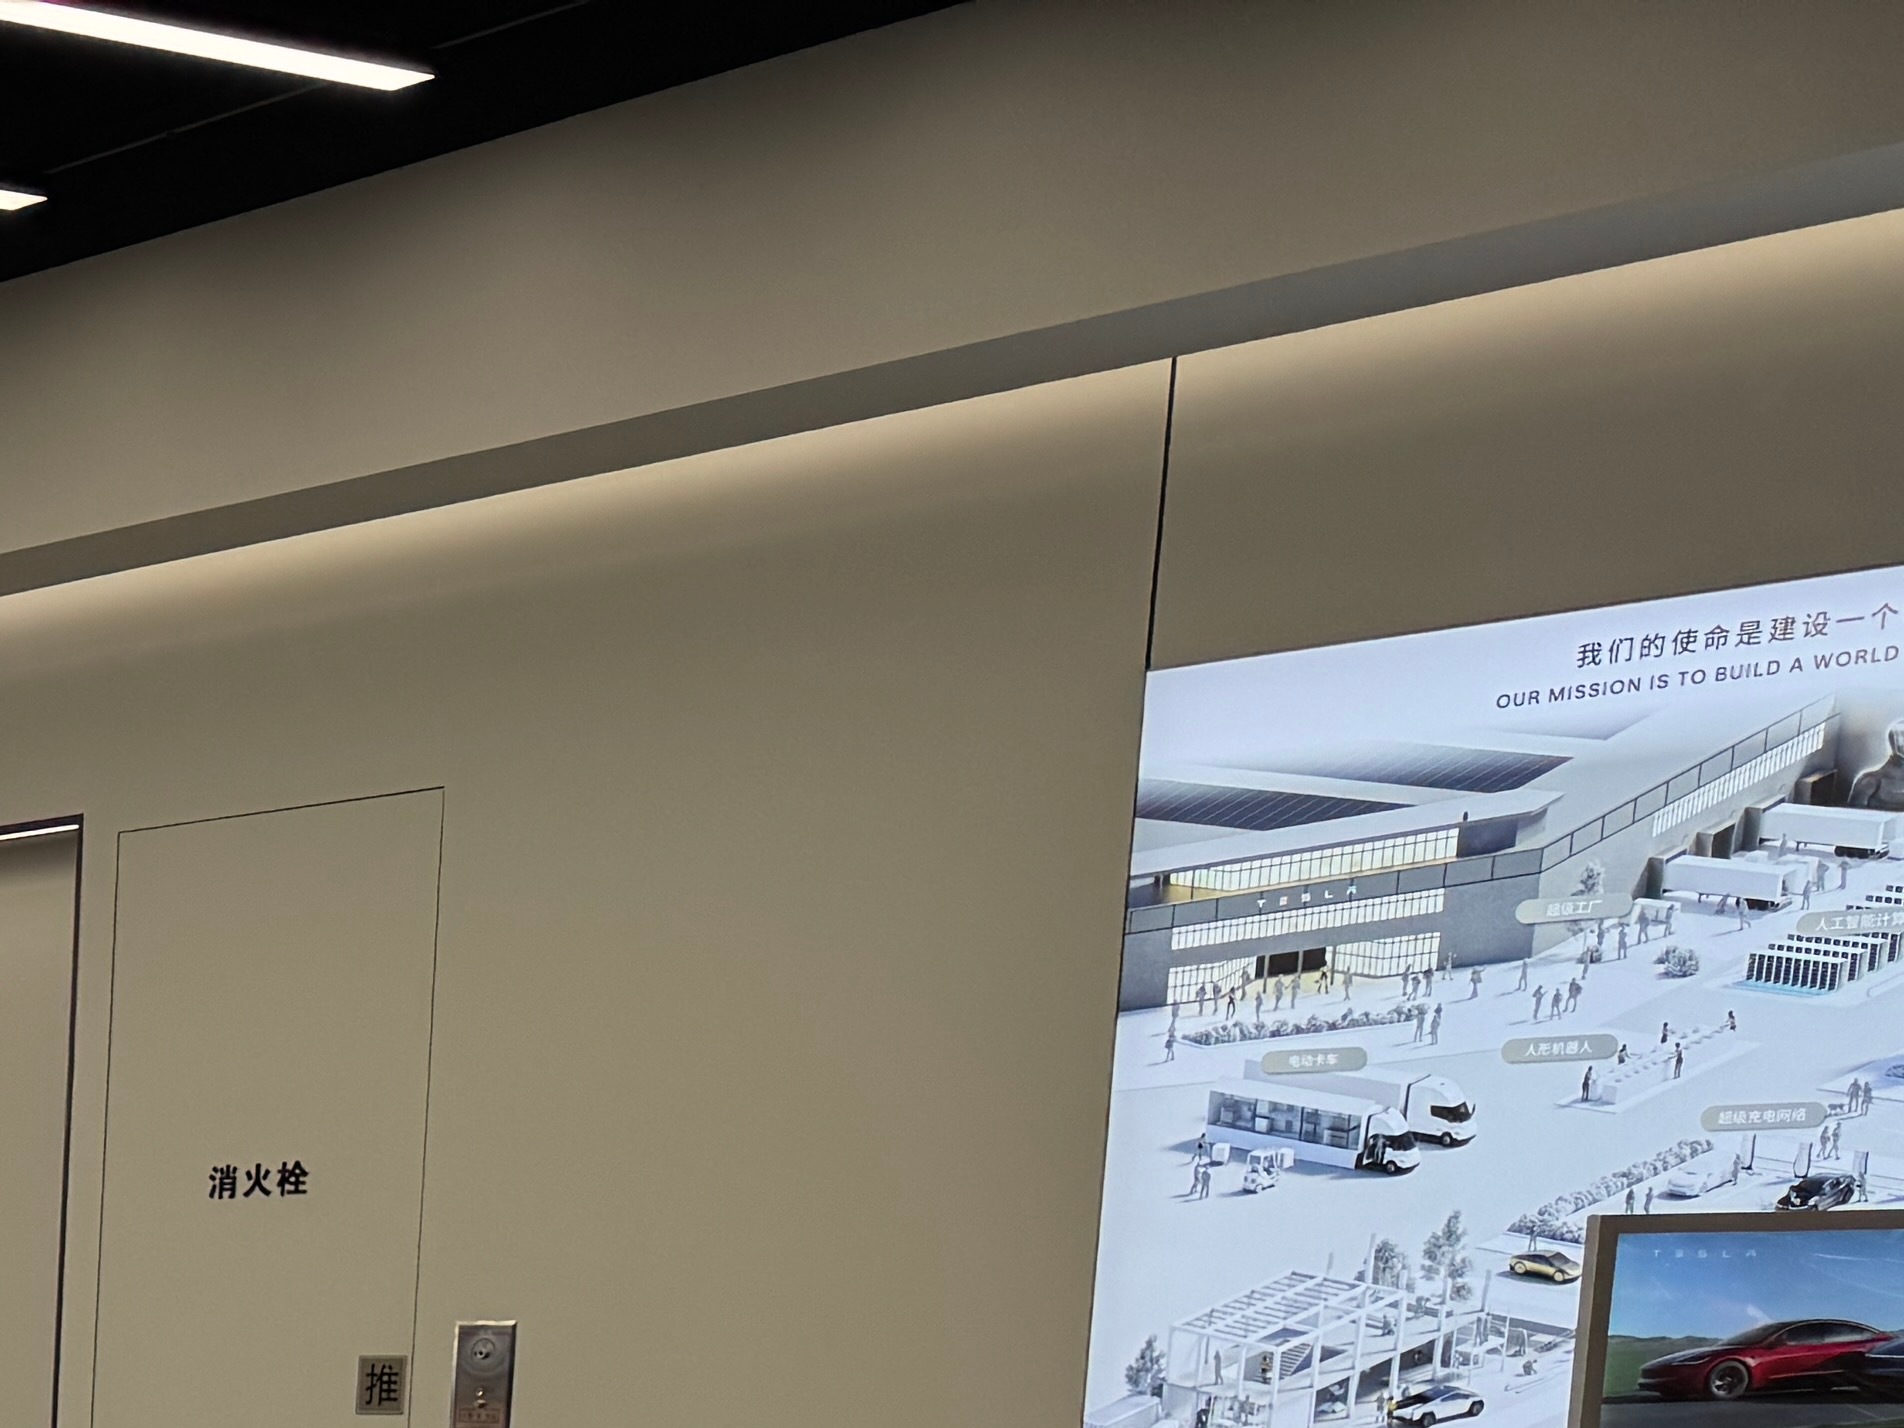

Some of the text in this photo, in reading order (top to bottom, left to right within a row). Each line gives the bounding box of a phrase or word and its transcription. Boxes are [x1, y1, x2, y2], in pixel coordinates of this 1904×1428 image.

[1576, 602, 1900, 670] 我们的使命是建设一个
[1495, 644, 1901, 709] OUR MISSION IS TO BUILD A WORLD
[1288, 1053, 1340, 1069] 电动卡车
[1524, 1040, 1593, 1057] 人形机器人
[1718, 1107, 1807, 1125] 超级充电网络
[208, 1160, 310, 1200] 消火栓
[364, 1363, 399, 1407] 推
